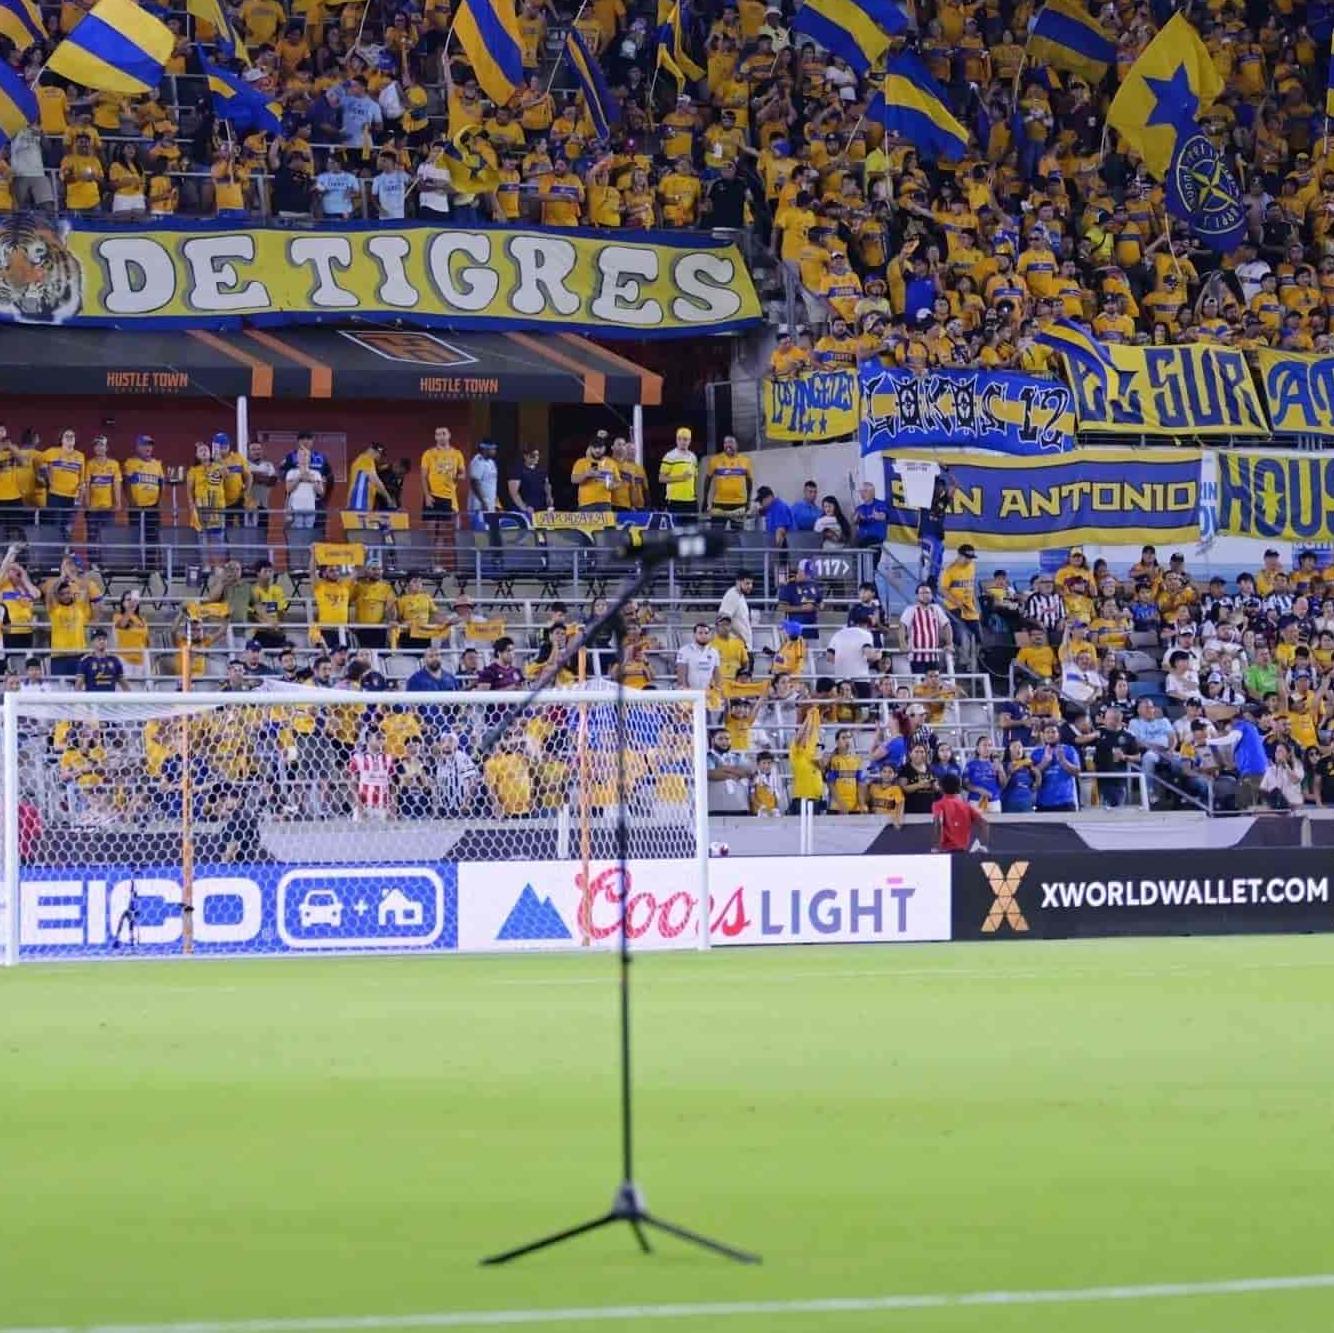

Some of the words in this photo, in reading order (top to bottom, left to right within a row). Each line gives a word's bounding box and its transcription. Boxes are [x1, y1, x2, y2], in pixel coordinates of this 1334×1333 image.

[98, 233, 271, 314] DE
[289, 231, 743, 325] TIGRES
[106, 372, 150, 387] HUSTLE
[153, 372, 188, 388] TOWN
[420, 377, 461, 393] HUSTLE
[464, 377, 499, 394] TOWN
[1145, 343, 1259, 428] SUR
[863, 370, 1007, 443] LOKOS
[1018, 384, 1071, 452] 12
[891, 479, 981, 516] SN
[999, 481, 1197, 519] ANTONIO
[814, 559, 842, 577] 117
[575, 867, 754, 939] Coos
[761, 878, 916, 936] LIGHT
[1040, 876, 1329, 909] XWORLDWALLET.COM
